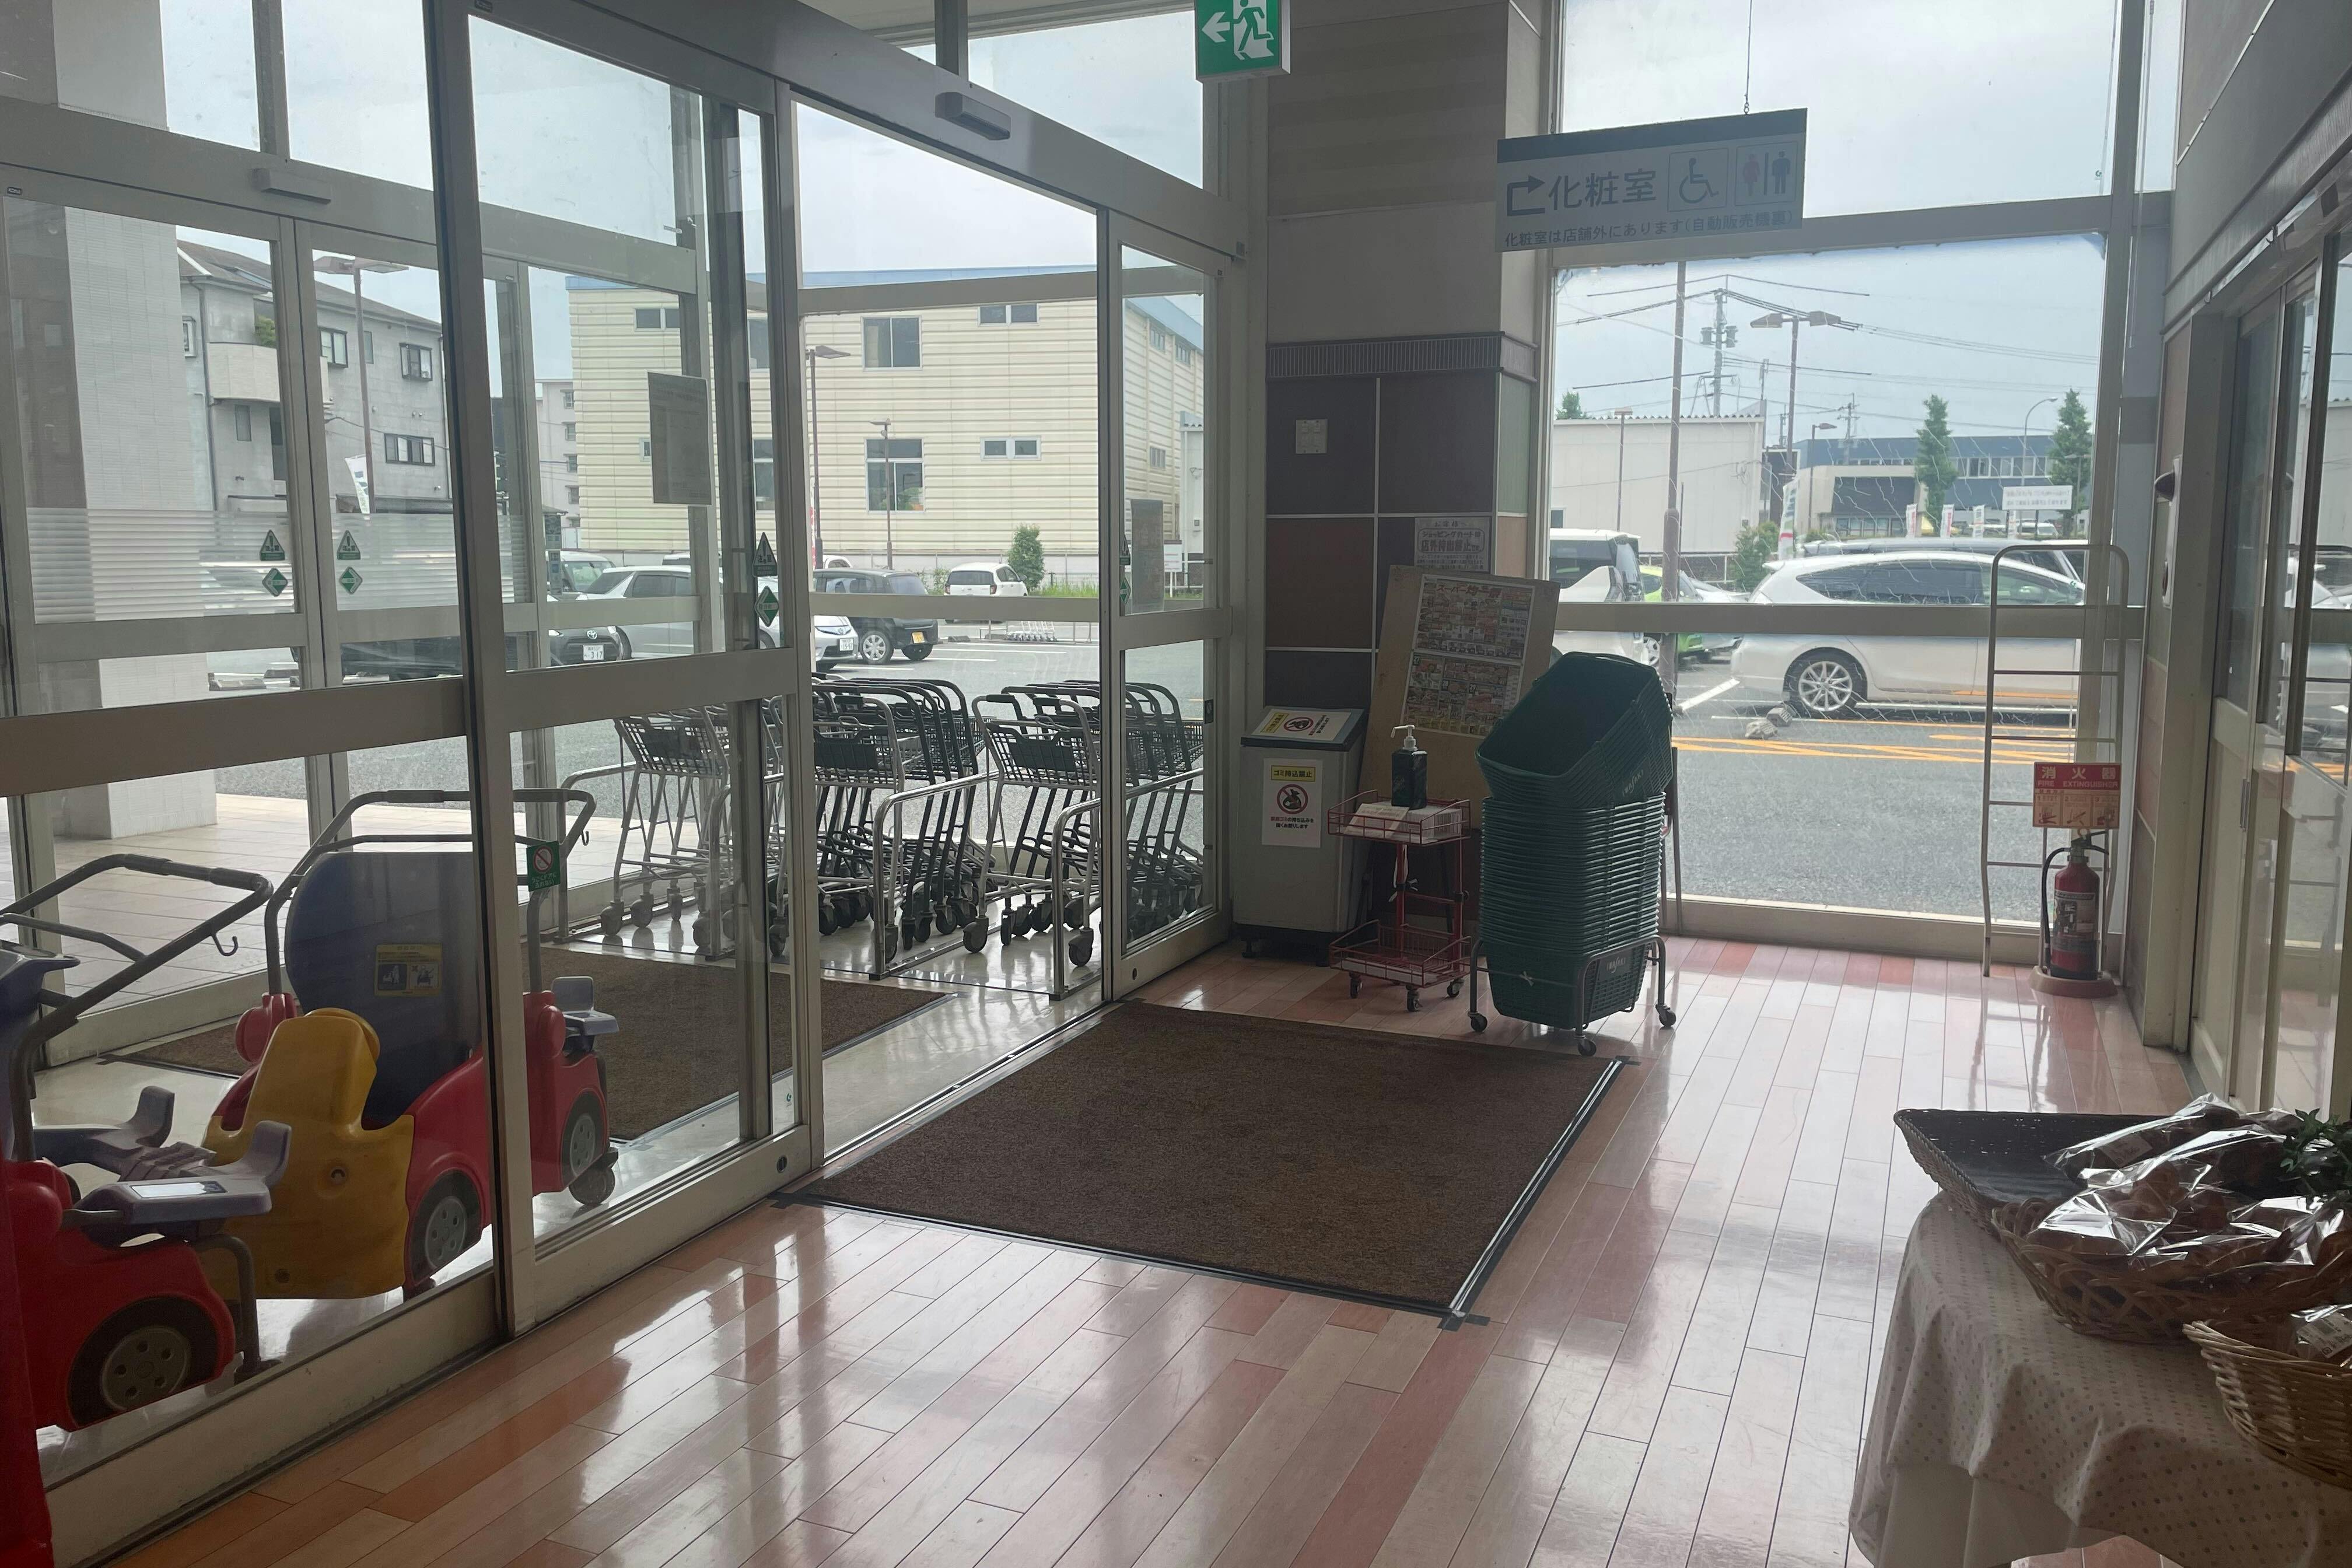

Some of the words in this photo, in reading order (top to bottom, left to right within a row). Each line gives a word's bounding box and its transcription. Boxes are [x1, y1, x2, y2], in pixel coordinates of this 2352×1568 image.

[1549, 168, 1657, 211] 化粧室
[1273, 769, 1312, 778] ゴミ持込禁止
